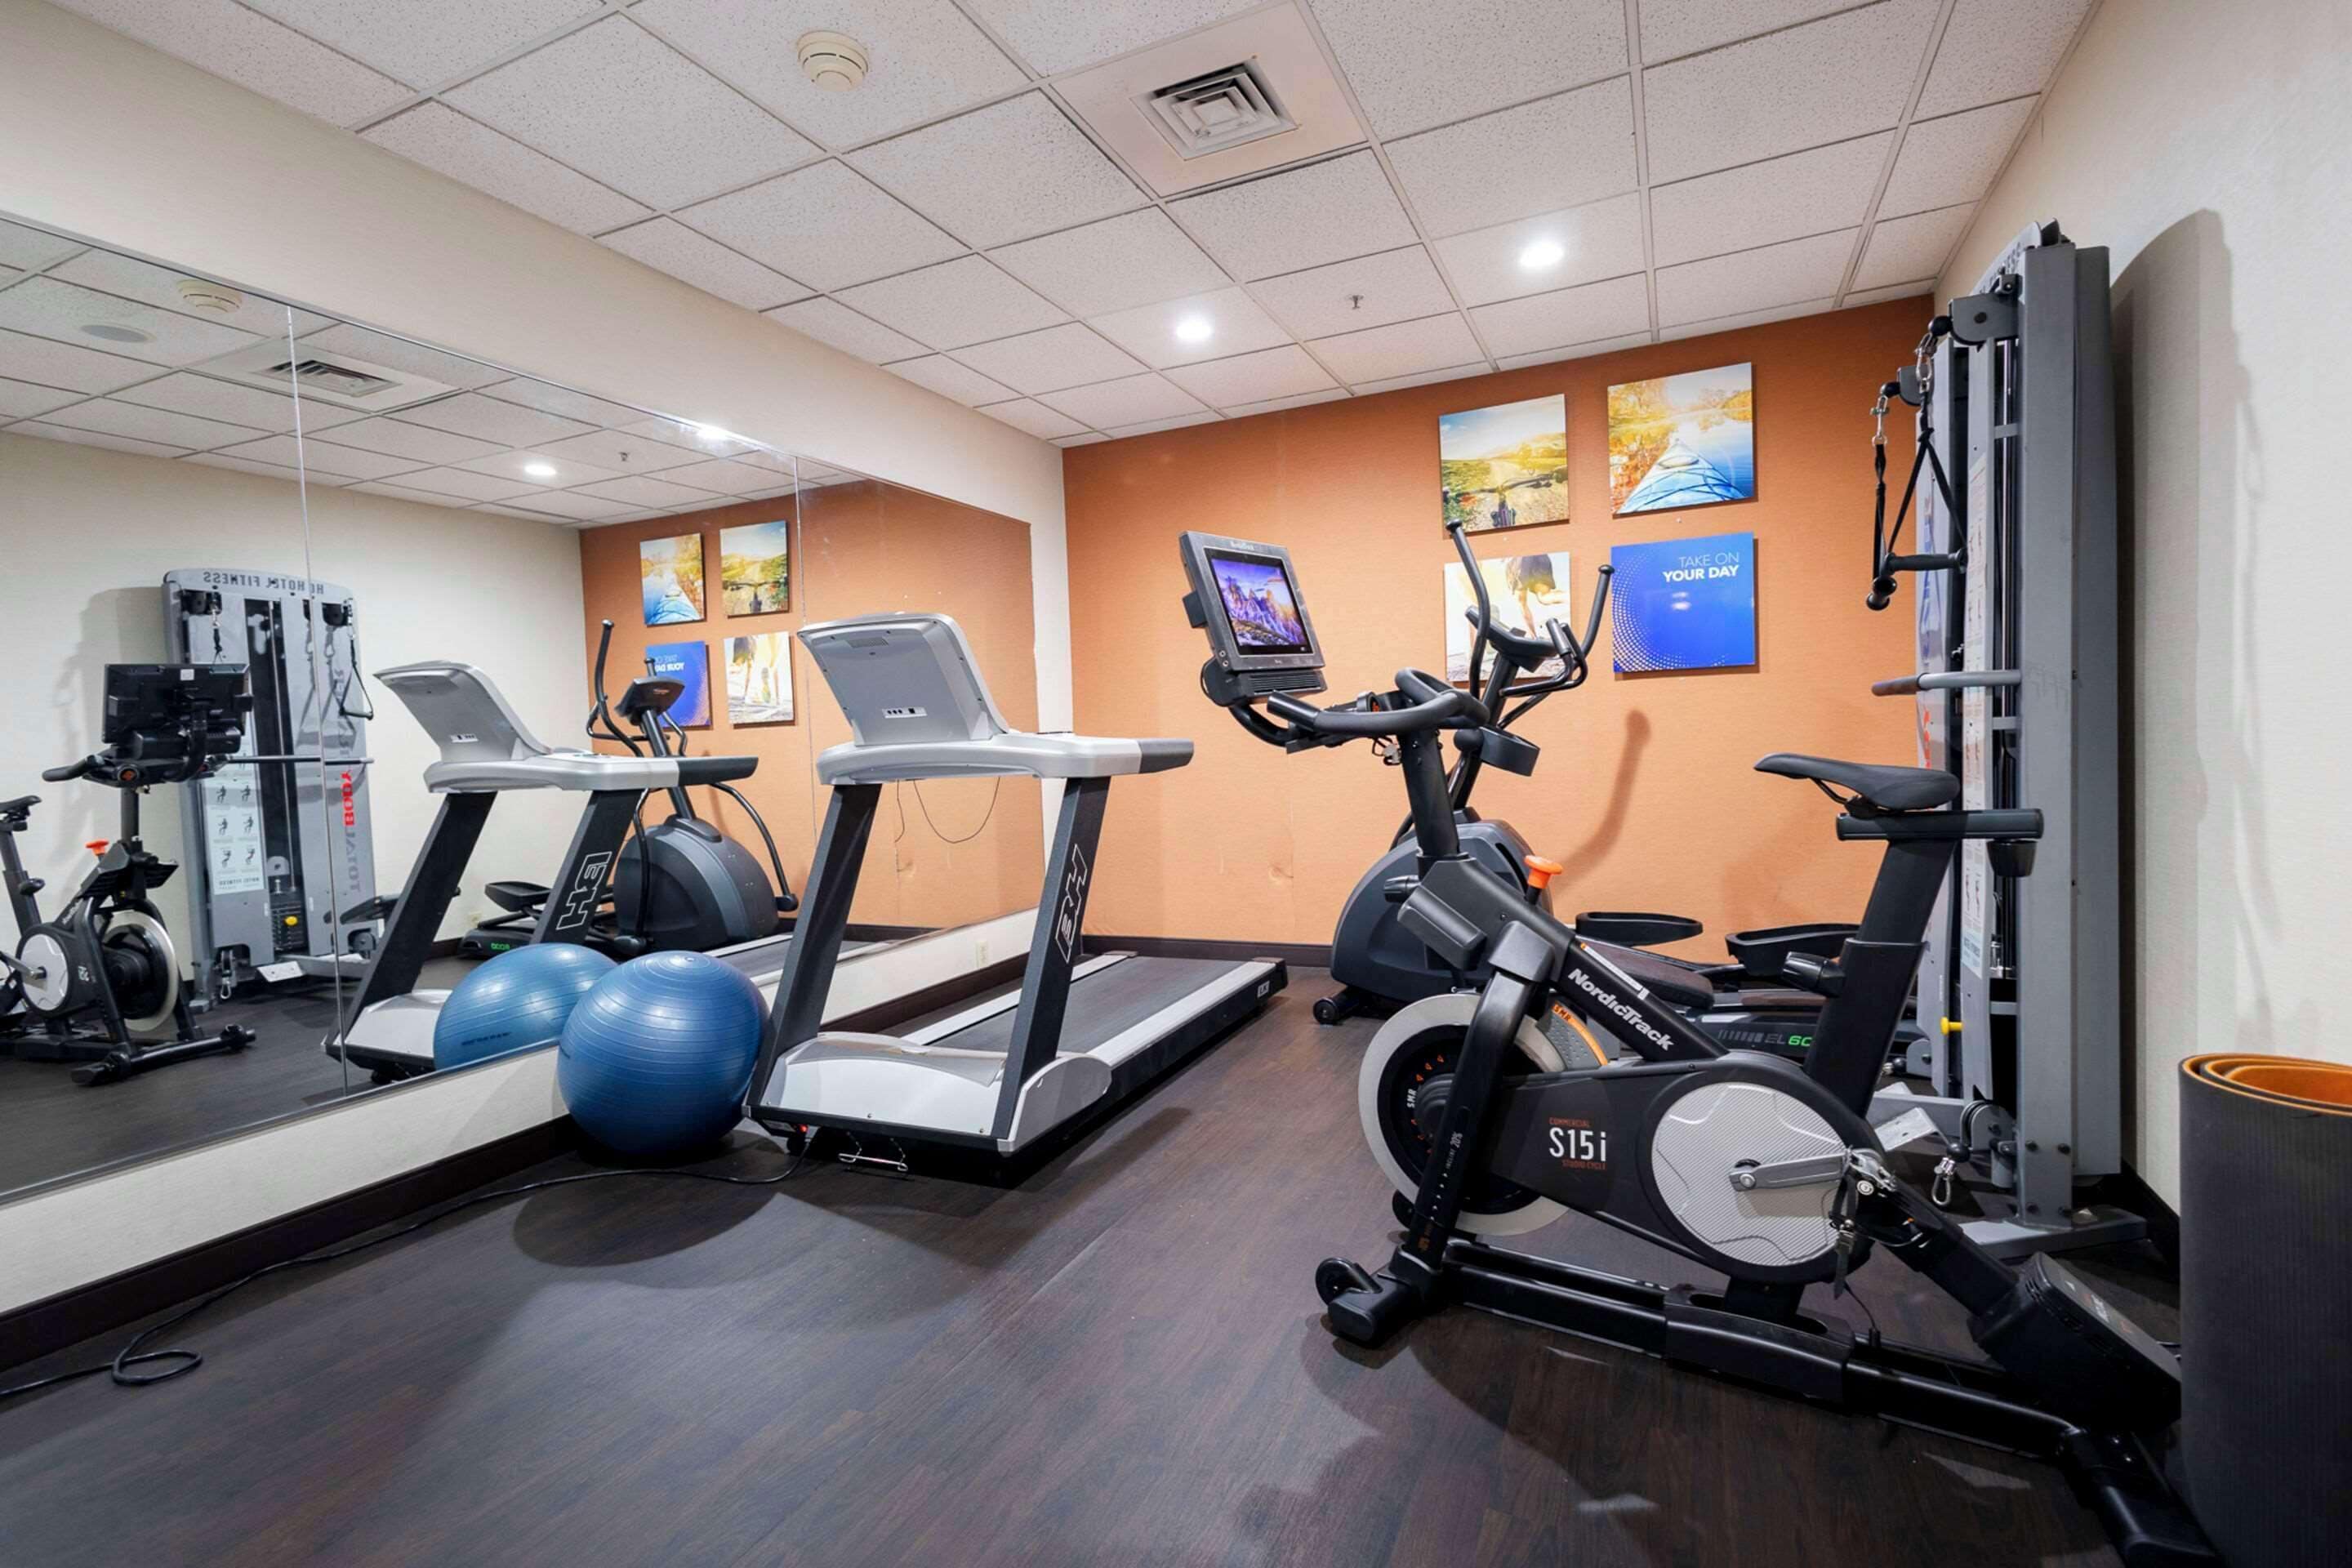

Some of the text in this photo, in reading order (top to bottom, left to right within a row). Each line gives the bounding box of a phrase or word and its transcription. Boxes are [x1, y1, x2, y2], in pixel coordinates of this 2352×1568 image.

[1679, 552, 1740, 568] TAKE ON
[1663, 564, 1740, 582] YOUR DAY
[1567, 968, 1674, 1051] NordicTrack
[1406, 1088, 1418, 1109] SMR
[1548, 1127, 1606, 1161] S15i
